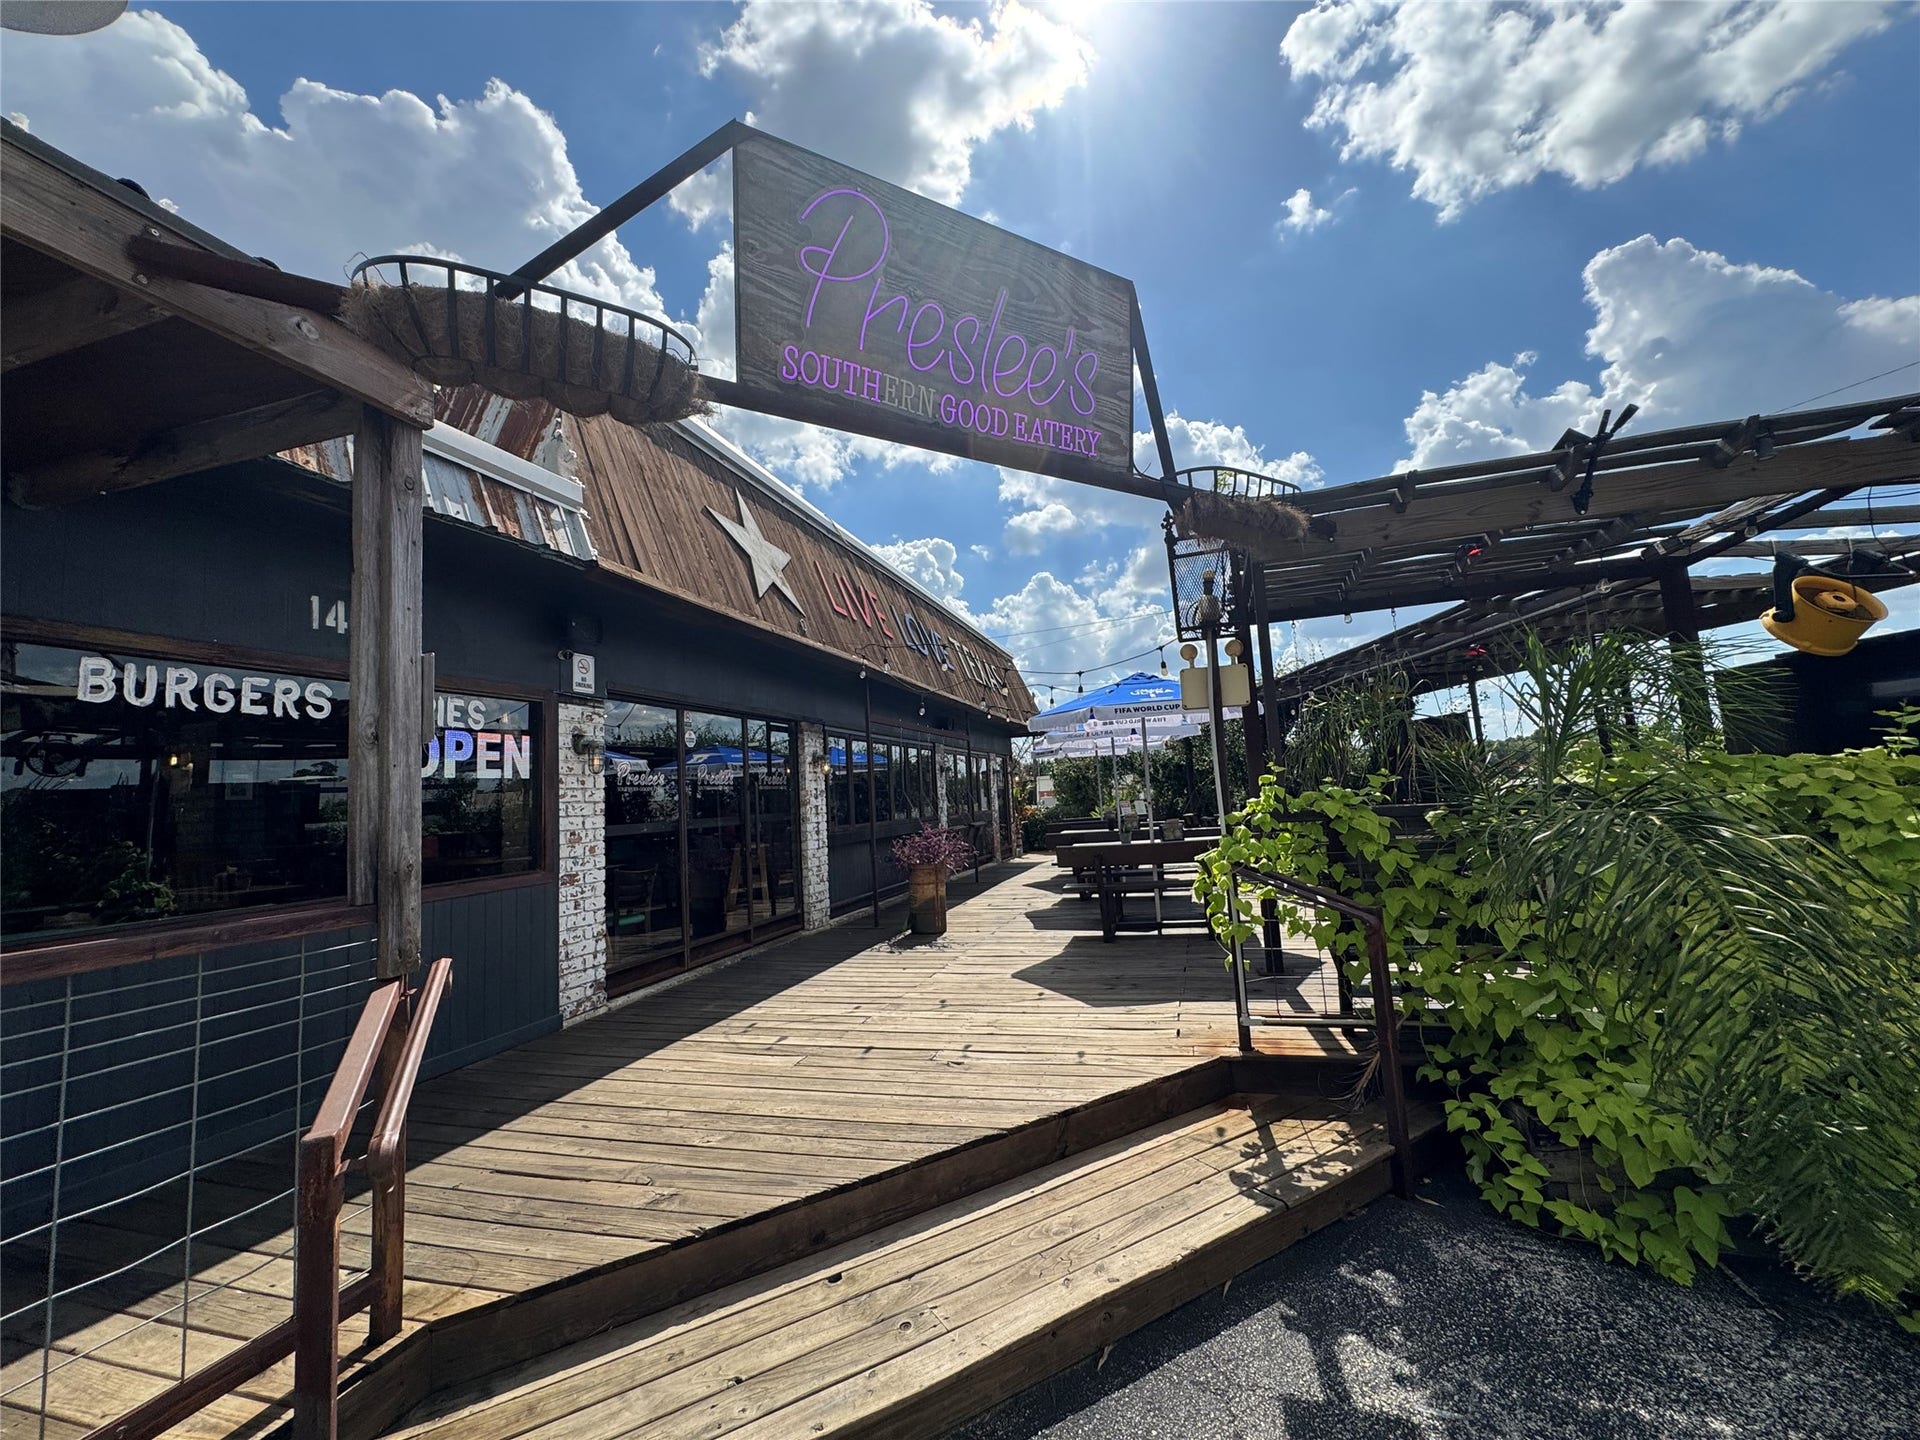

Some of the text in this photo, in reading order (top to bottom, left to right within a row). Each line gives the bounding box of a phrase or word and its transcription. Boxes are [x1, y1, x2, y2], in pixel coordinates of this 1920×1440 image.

[800, 188, 1099, 416] Preslee's
[781, 345, 1102, 457] SOUTHERN GOOD EATERY
[310, 595, 348, 634] 14
[815, 560, 1005, 694] LIVE LOVE TEXAS
[76, 656, 334, 720] BURGERS
[433, 695, 486, 731] IES
[1114, 703, 1181, 715] FIFA WORLD CUP
